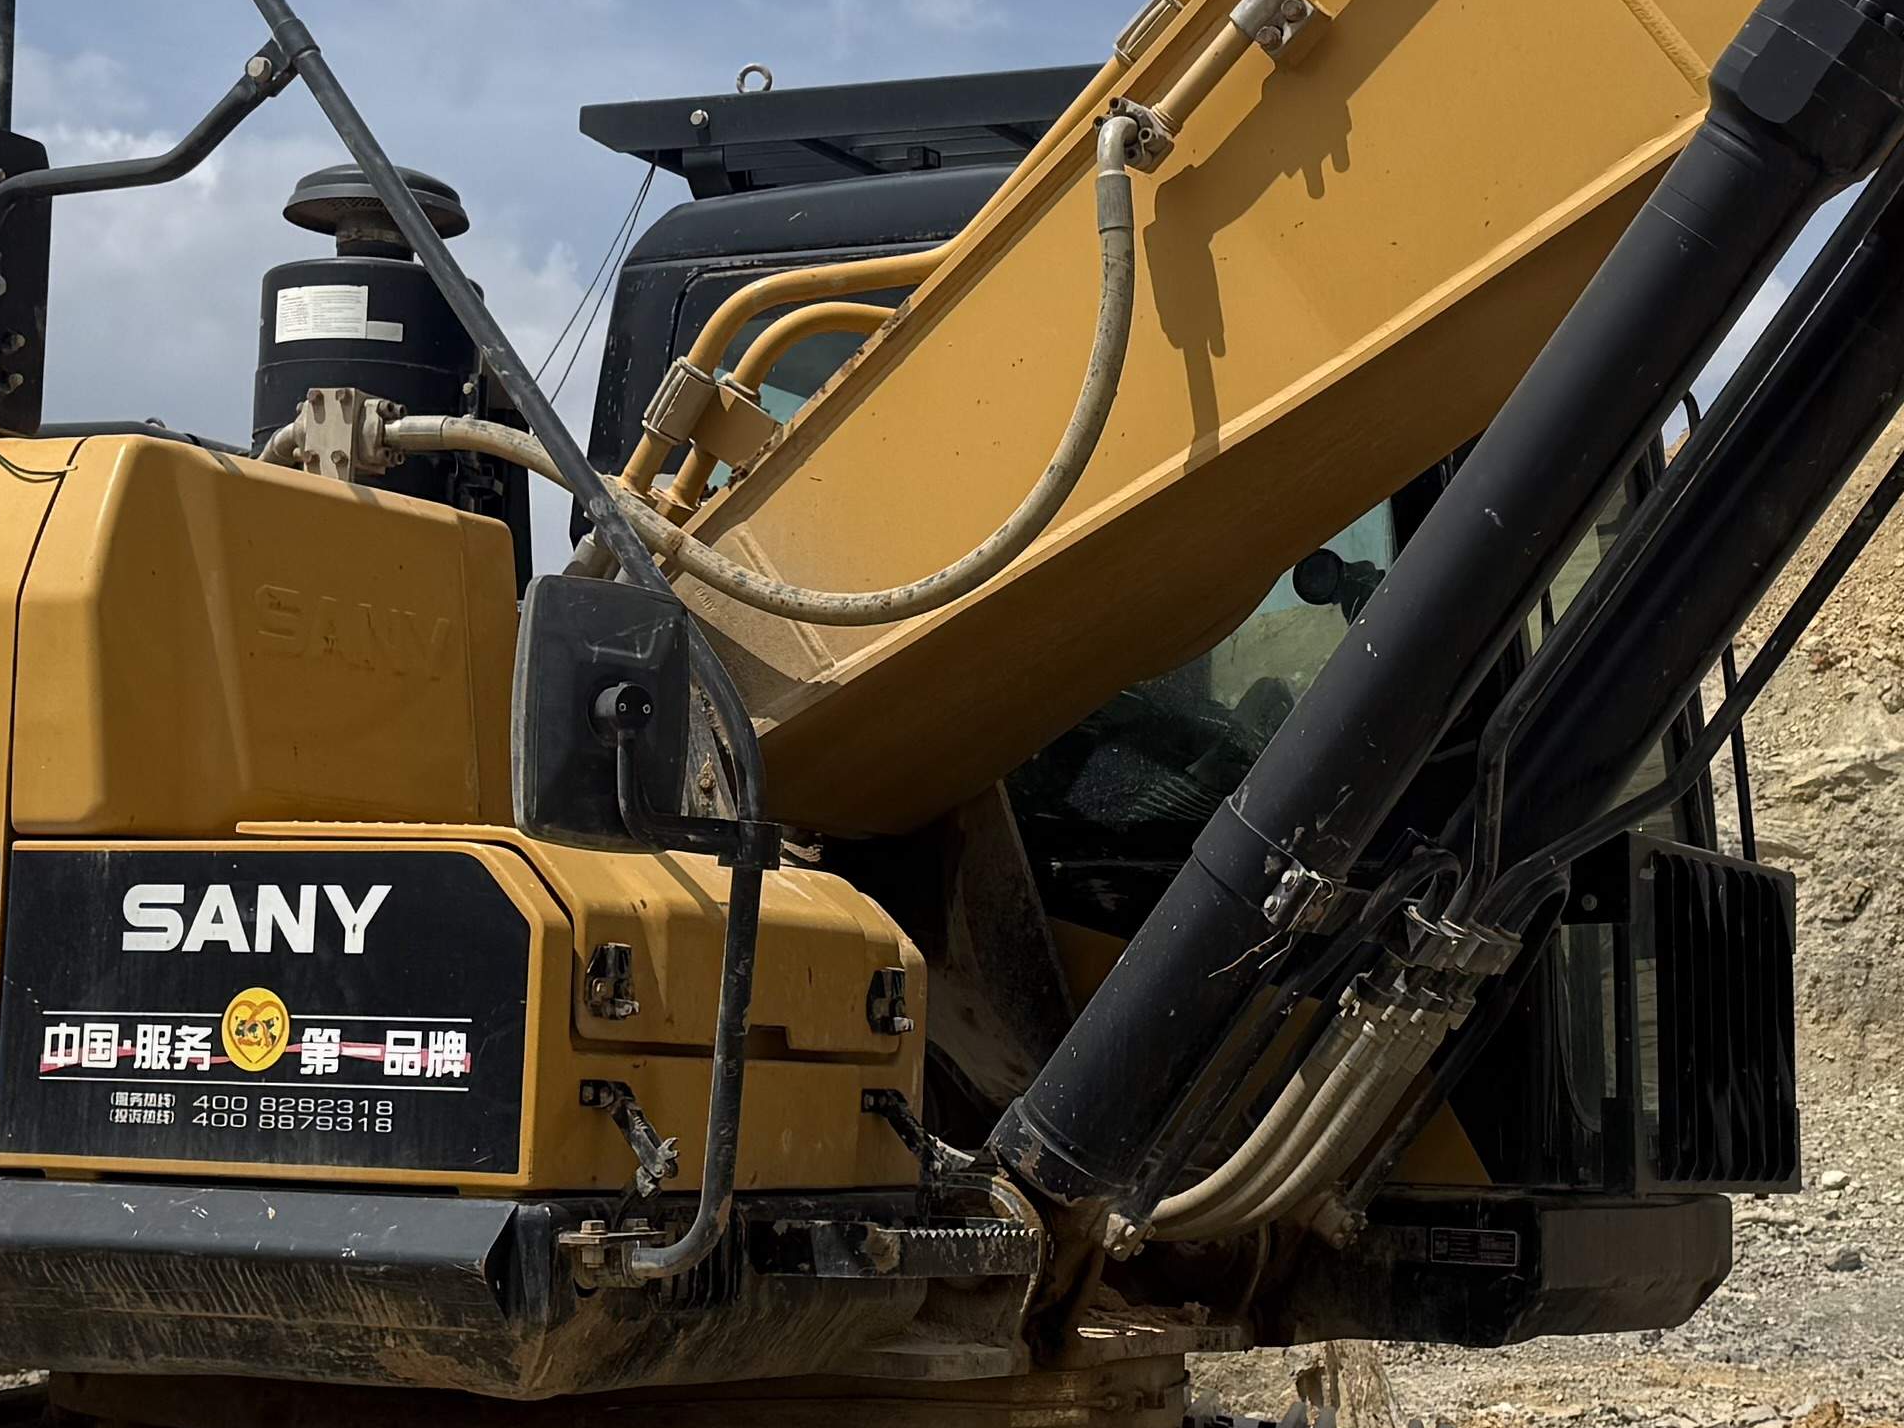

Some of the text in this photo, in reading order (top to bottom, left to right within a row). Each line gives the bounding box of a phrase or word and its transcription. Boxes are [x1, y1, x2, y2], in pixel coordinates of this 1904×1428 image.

[252, 582, 452, 682] SANY
[121, 883, 393, 955] SANY
[298, 1027, 471, 1079] 第一品牌
[192, 1095, 248, 1111] 400
[259, 1096, 393, 1116] 8282318
[192, 1112, 247, 1128] 400
[258, 1113, 393, 1133] 8879318
